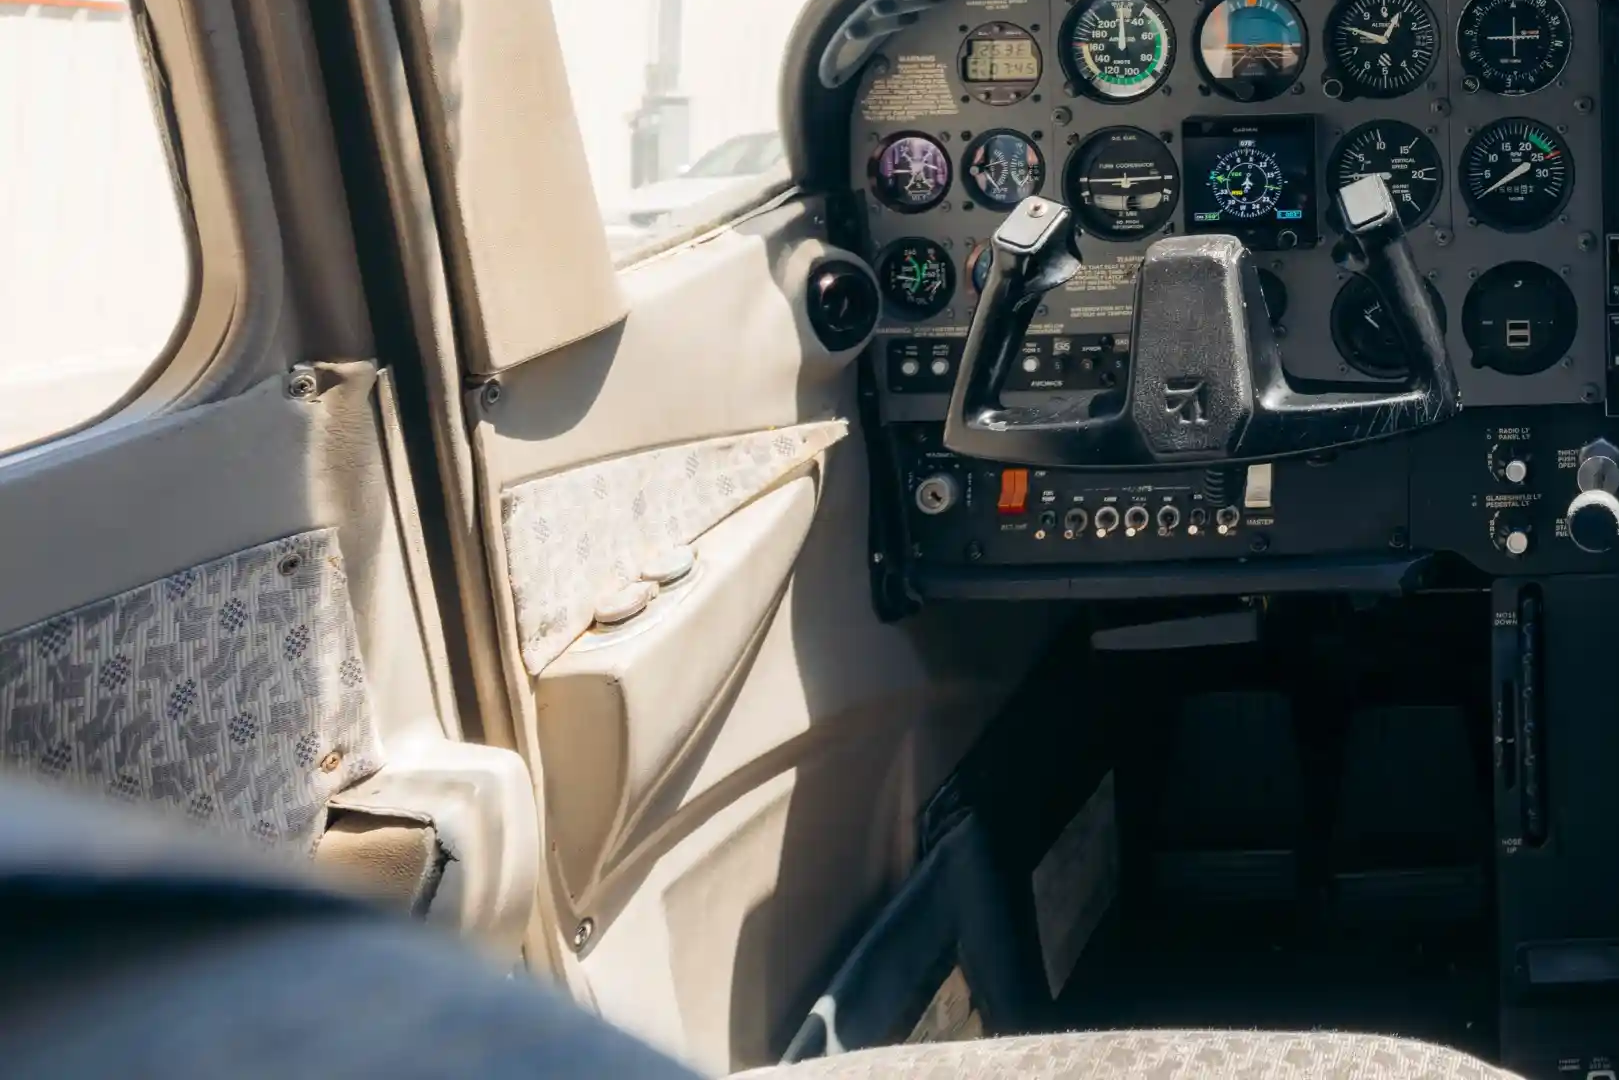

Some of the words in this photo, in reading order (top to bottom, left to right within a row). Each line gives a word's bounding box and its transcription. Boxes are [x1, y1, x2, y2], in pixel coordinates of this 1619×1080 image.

[1363, 12, 1370, 20] 9
[1097, 20, 1116, 29] 200
[1411, 22, 1418, 30] 2
[1092, 30, 1107, 38] 180
[1141, 32, 1154, 40] 60
[1090, 43, 1105, 51] 160
[1412, 49, 1419, 57] 3
[1095, 54, 1110, 63] 140
[1364, 61, 1371, 69] 6
[1400, 60, 1408, 68] 4
[1105, 66, 1120, 74] 120
[1382, 68, 1389, 76] 5
[1124, 71, 1139, 79] 100
[1376, 141, 1386, 150] 10
[1501, 143, 1511, 151] 15
[1518, 143, 1532, 151] 20
[1400, 146, 1409, 154] 15
[1488, 154, 1498, 162] 10
[1531, 153, 1544, 161] 25
[1411, 170, 1424, 178] 20
[1484, 170, 1491, 178] 5
[1535, 169, 1548, 177] 30
[1402, 193, 1411, 201] 15
[1030, 379, 1063, 387] AVIONICS
[1502, 838, 1523, 846] NOSE
[1506, 846, 1517, 854] UP
